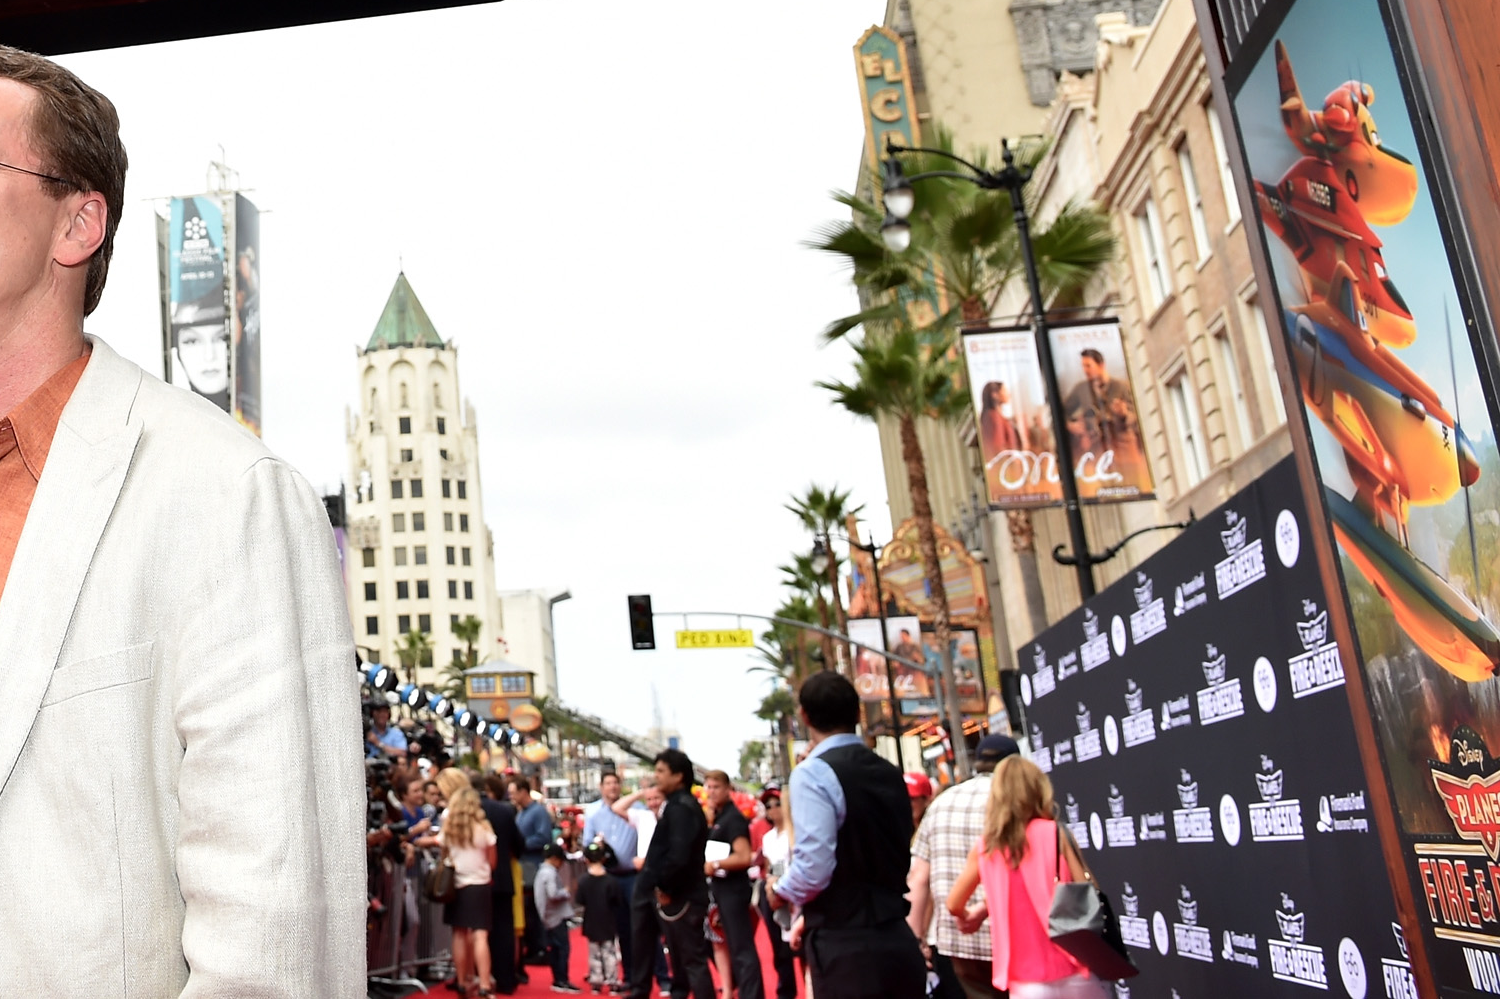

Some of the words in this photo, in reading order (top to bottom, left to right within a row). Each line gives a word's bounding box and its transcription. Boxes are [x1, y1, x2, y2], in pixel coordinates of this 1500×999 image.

[860, 52, 903, 83] EL
[680, 632, 710, 645] PED
[1417, 857, 1483, 929] FIRE
[1474, 868, 1495, 924] &
